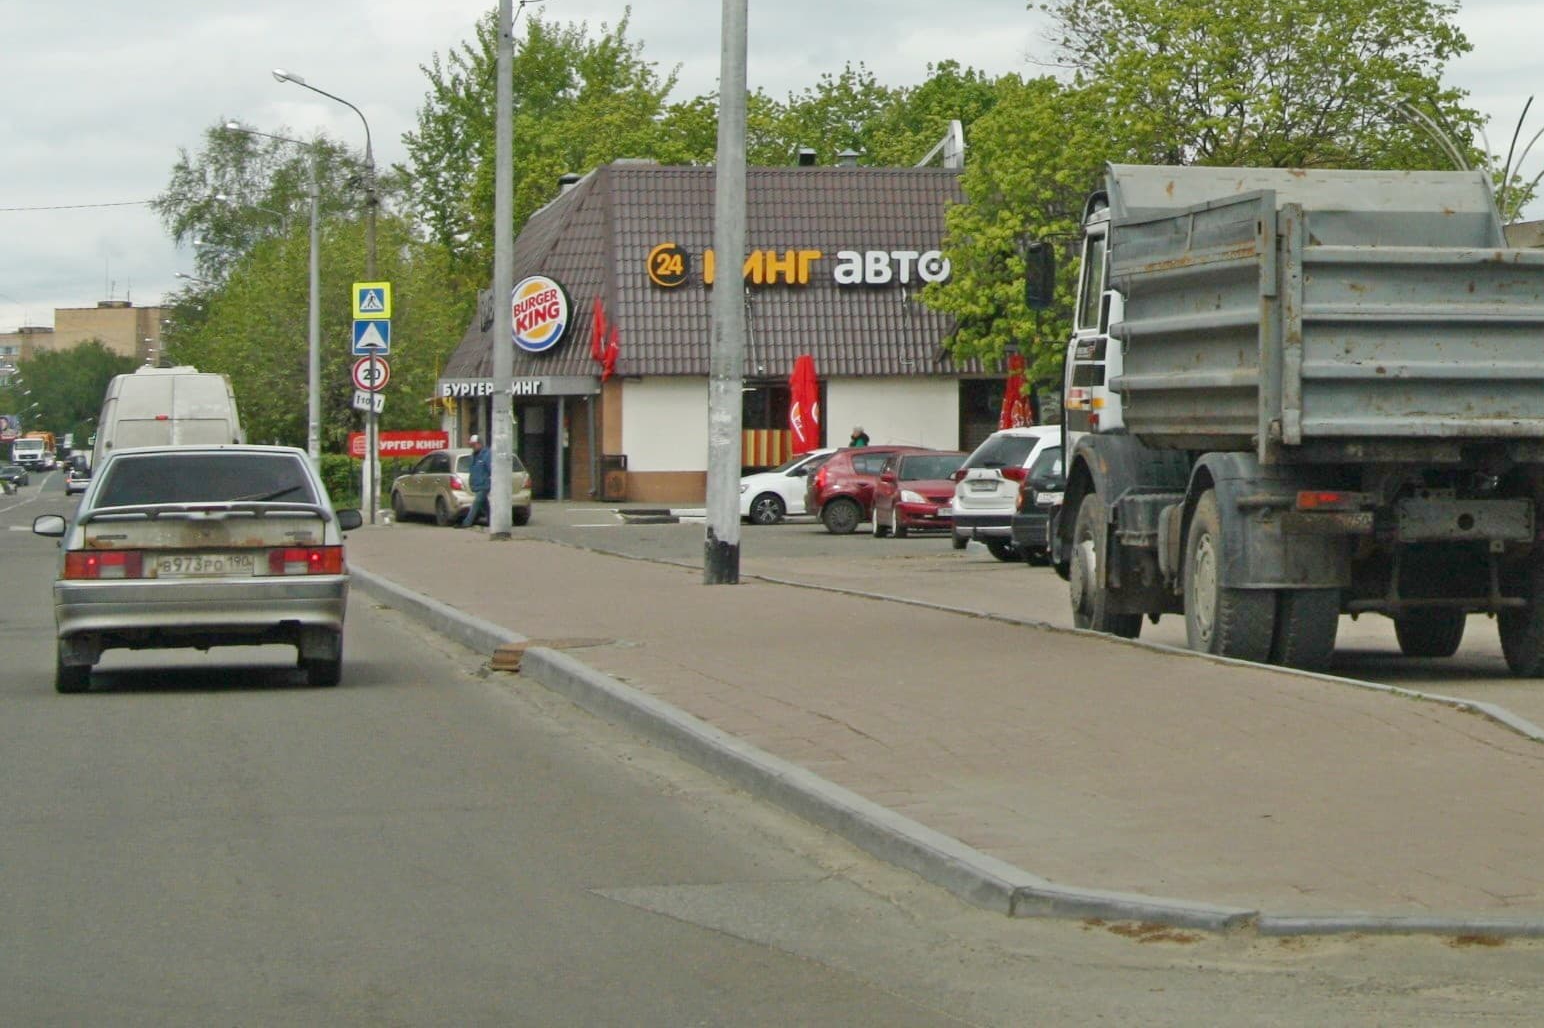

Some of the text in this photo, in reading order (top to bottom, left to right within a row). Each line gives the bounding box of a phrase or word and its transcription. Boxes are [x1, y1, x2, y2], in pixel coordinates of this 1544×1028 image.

[656, 253, 684, 276] 24
[703, 249, 822, 285] ИНГ
[513, 289, 558, 319] BURGER
[514, 301, 561, 336] KING
[363, 368, 381, 381] 20
[442, 380, 541, 397] БУРГЕР ИНГ
[380, 440, 447, 451] УРГЕР КИНГ
